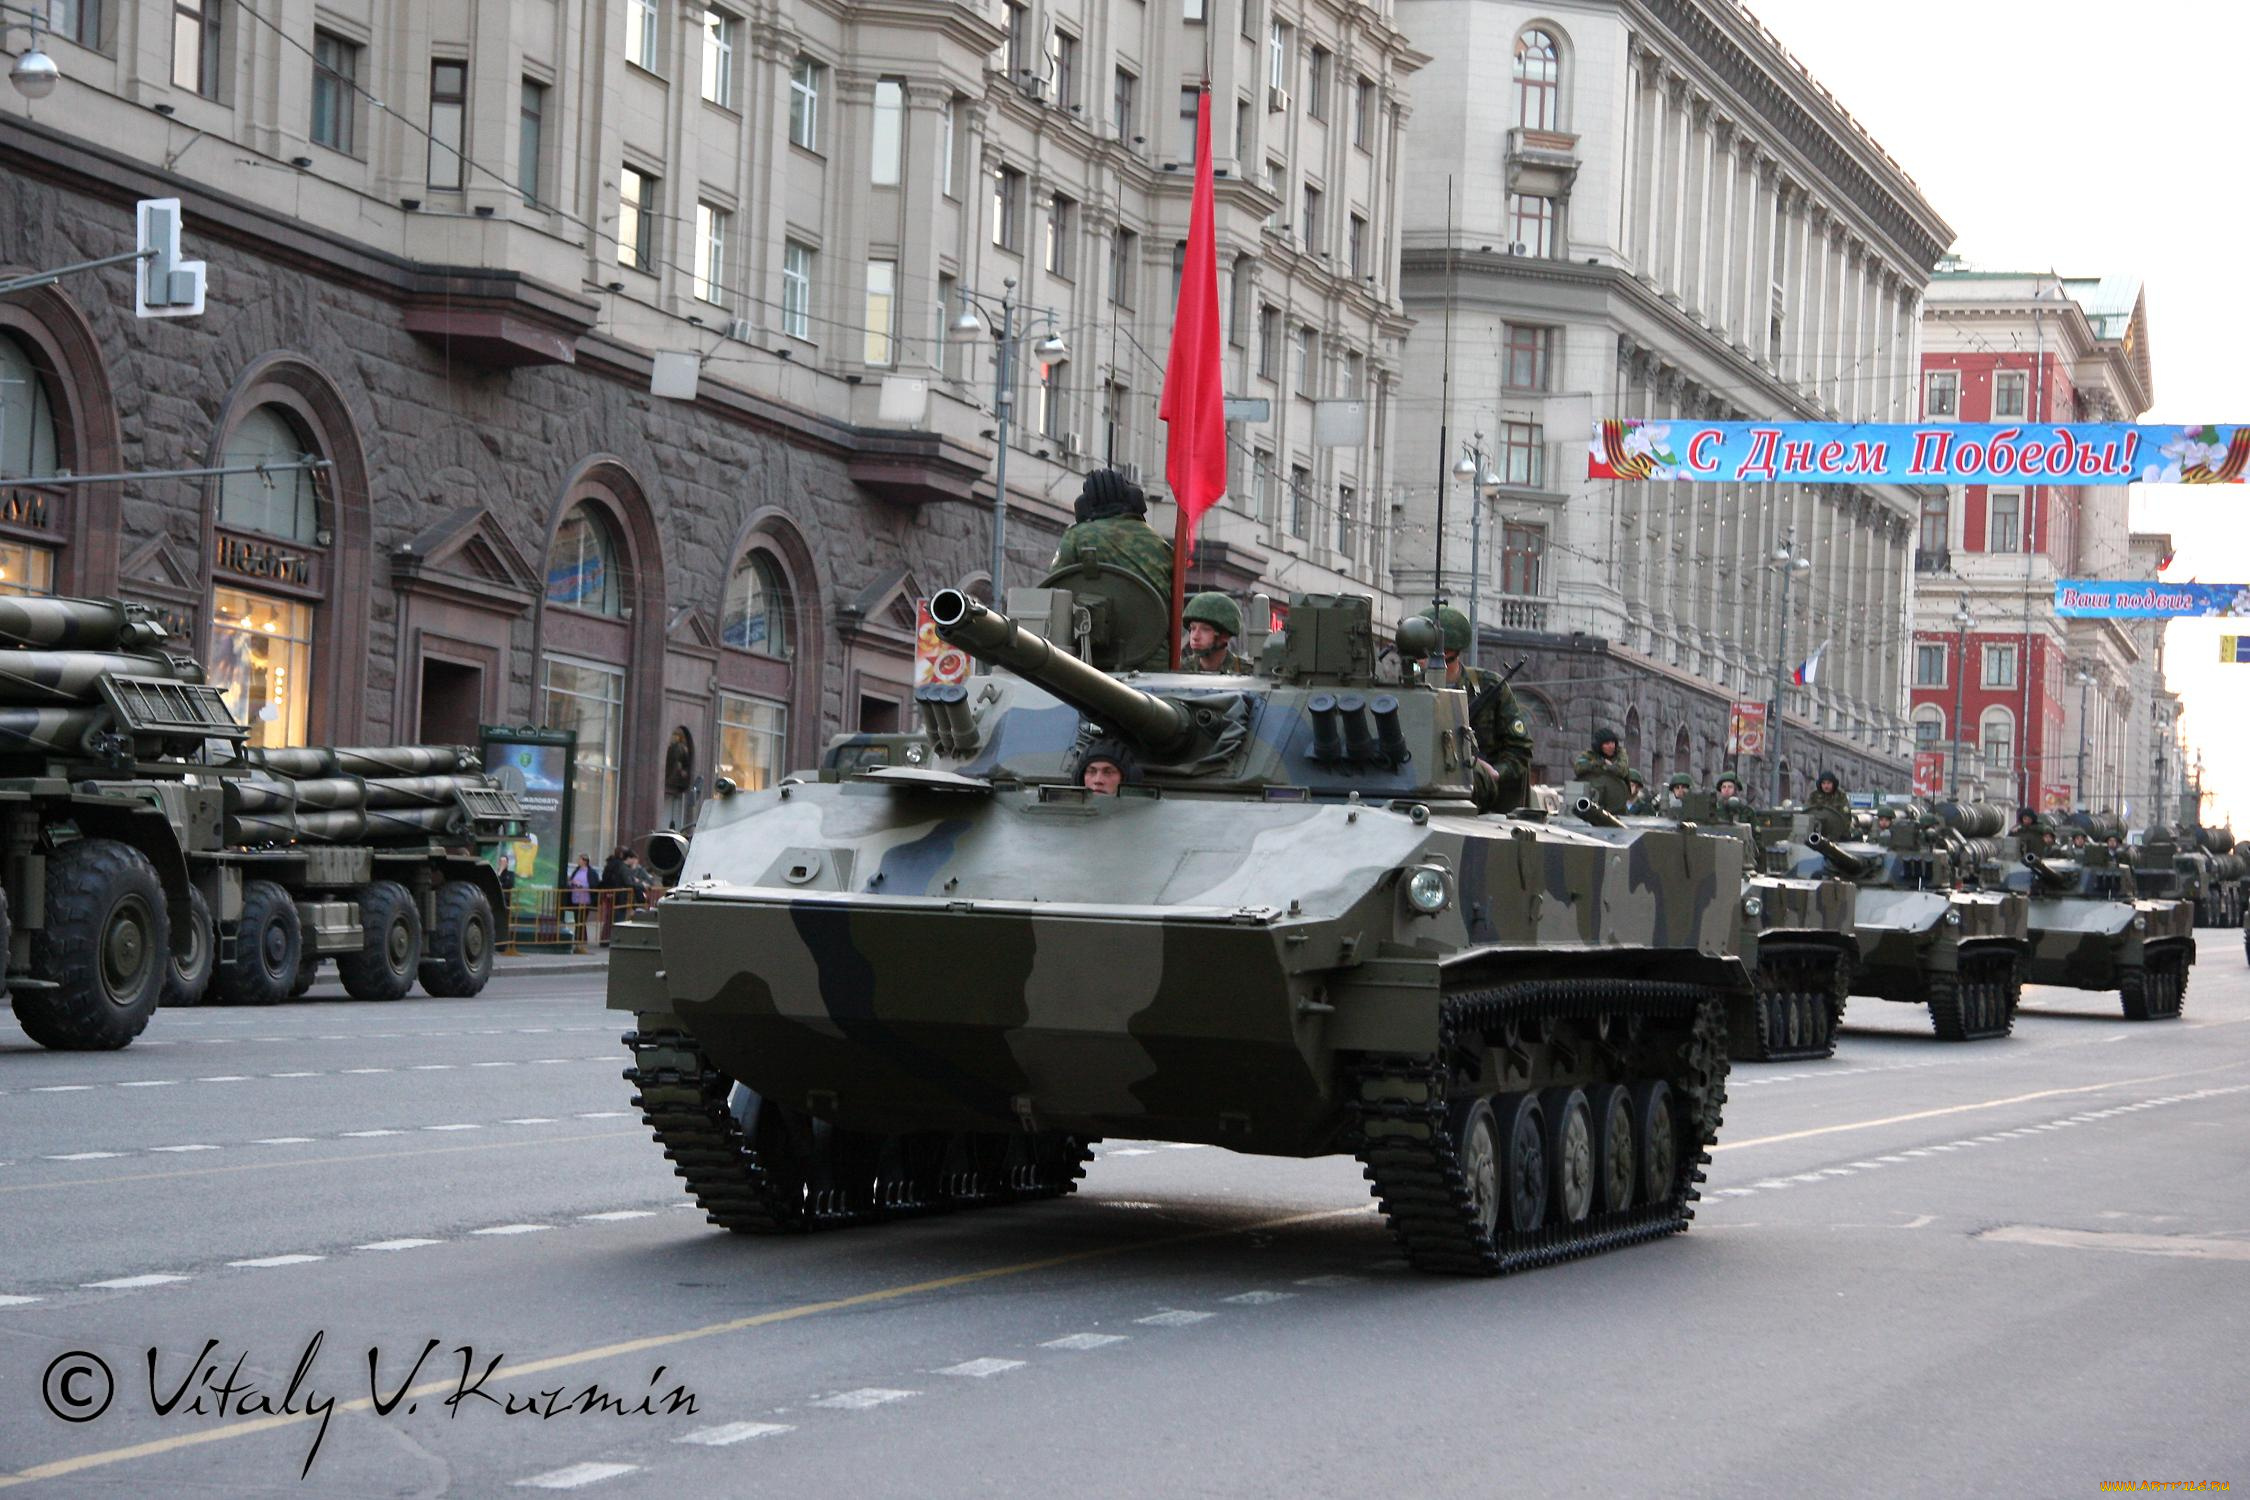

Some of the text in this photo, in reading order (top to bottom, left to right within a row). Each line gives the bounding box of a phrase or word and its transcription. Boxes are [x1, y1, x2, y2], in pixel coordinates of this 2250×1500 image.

[1687, 427, 2139, 481] С Днем Победы!
[2063, 587, 2110, 609] Ваш
[2115, 587, 2193, 610] подвиг
